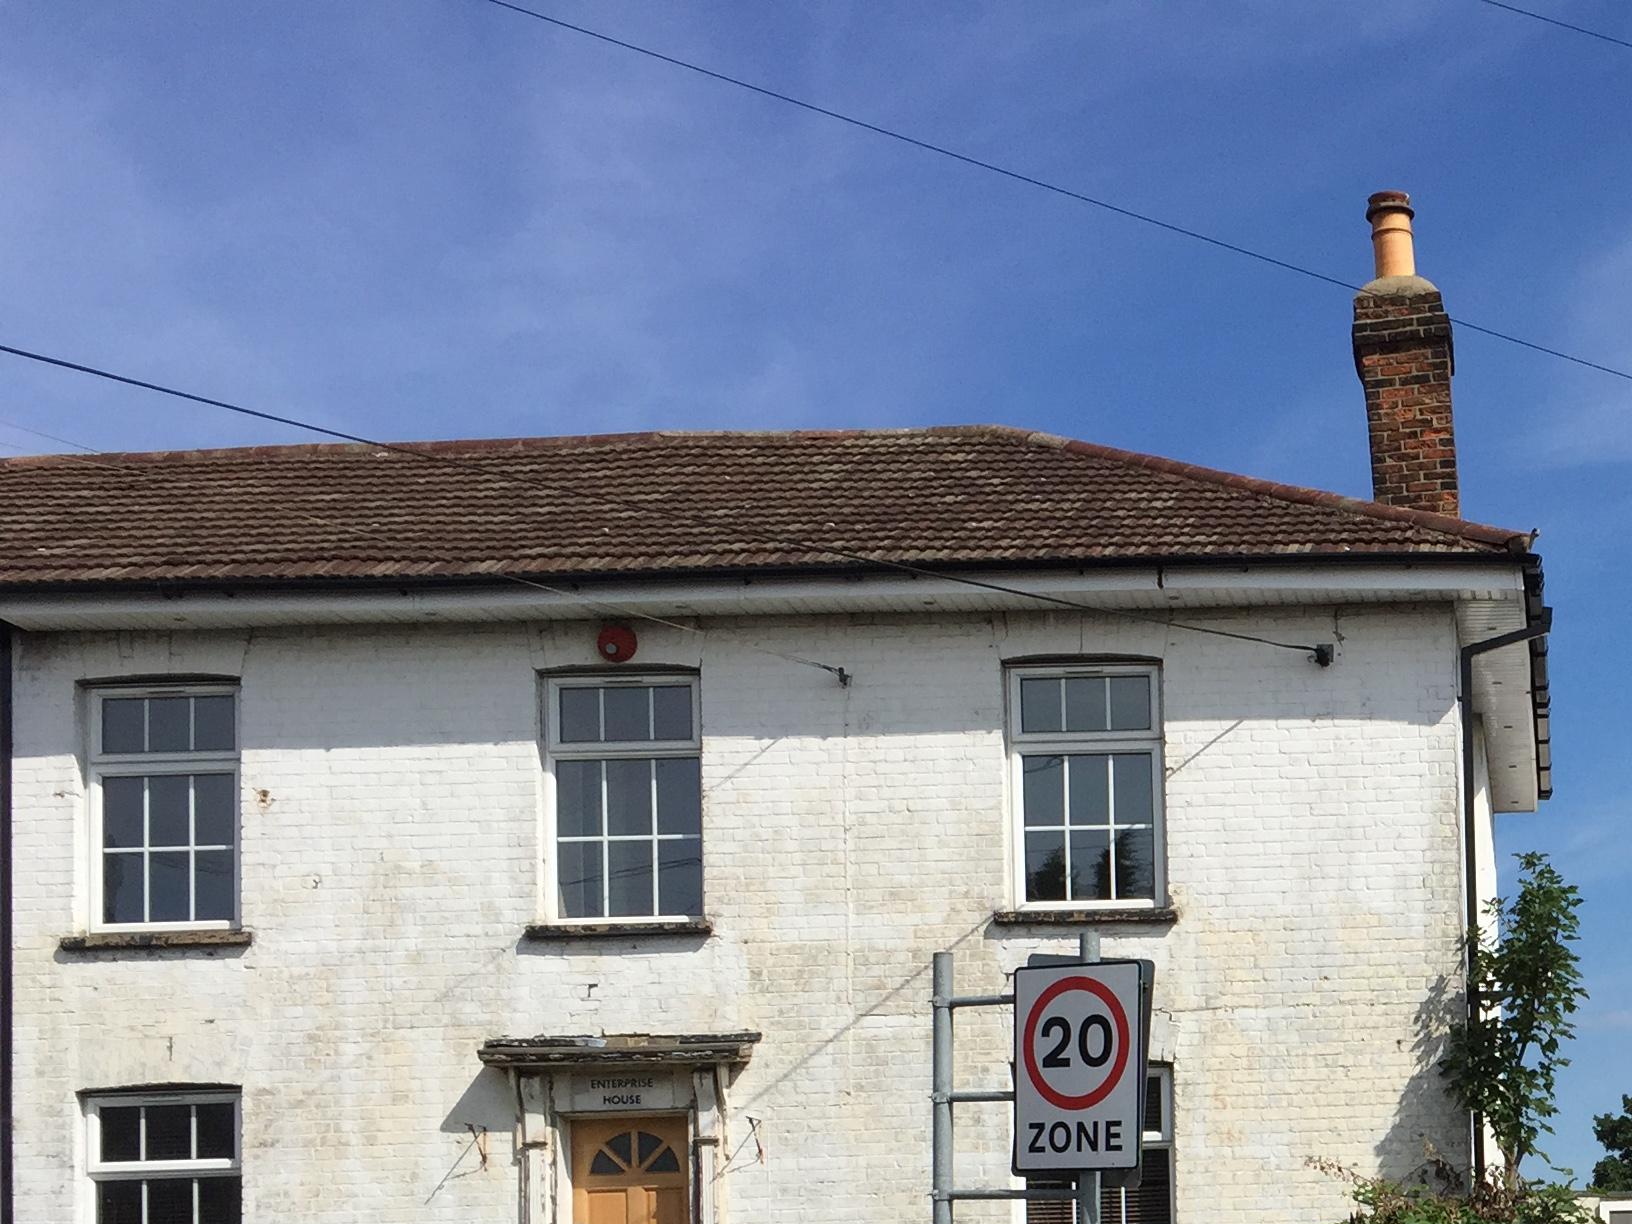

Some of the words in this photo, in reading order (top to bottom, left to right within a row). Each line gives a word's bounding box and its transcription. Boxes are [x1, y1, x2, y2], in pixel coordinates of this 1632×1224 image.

[1041, 1014, 1114, 1068] 20
[591, 1078, 654, 1089] ENTERPRISE
[603, 1094, 641, 1105] HOUSE
[1028, 1120, 1124, 1153] ZONE
